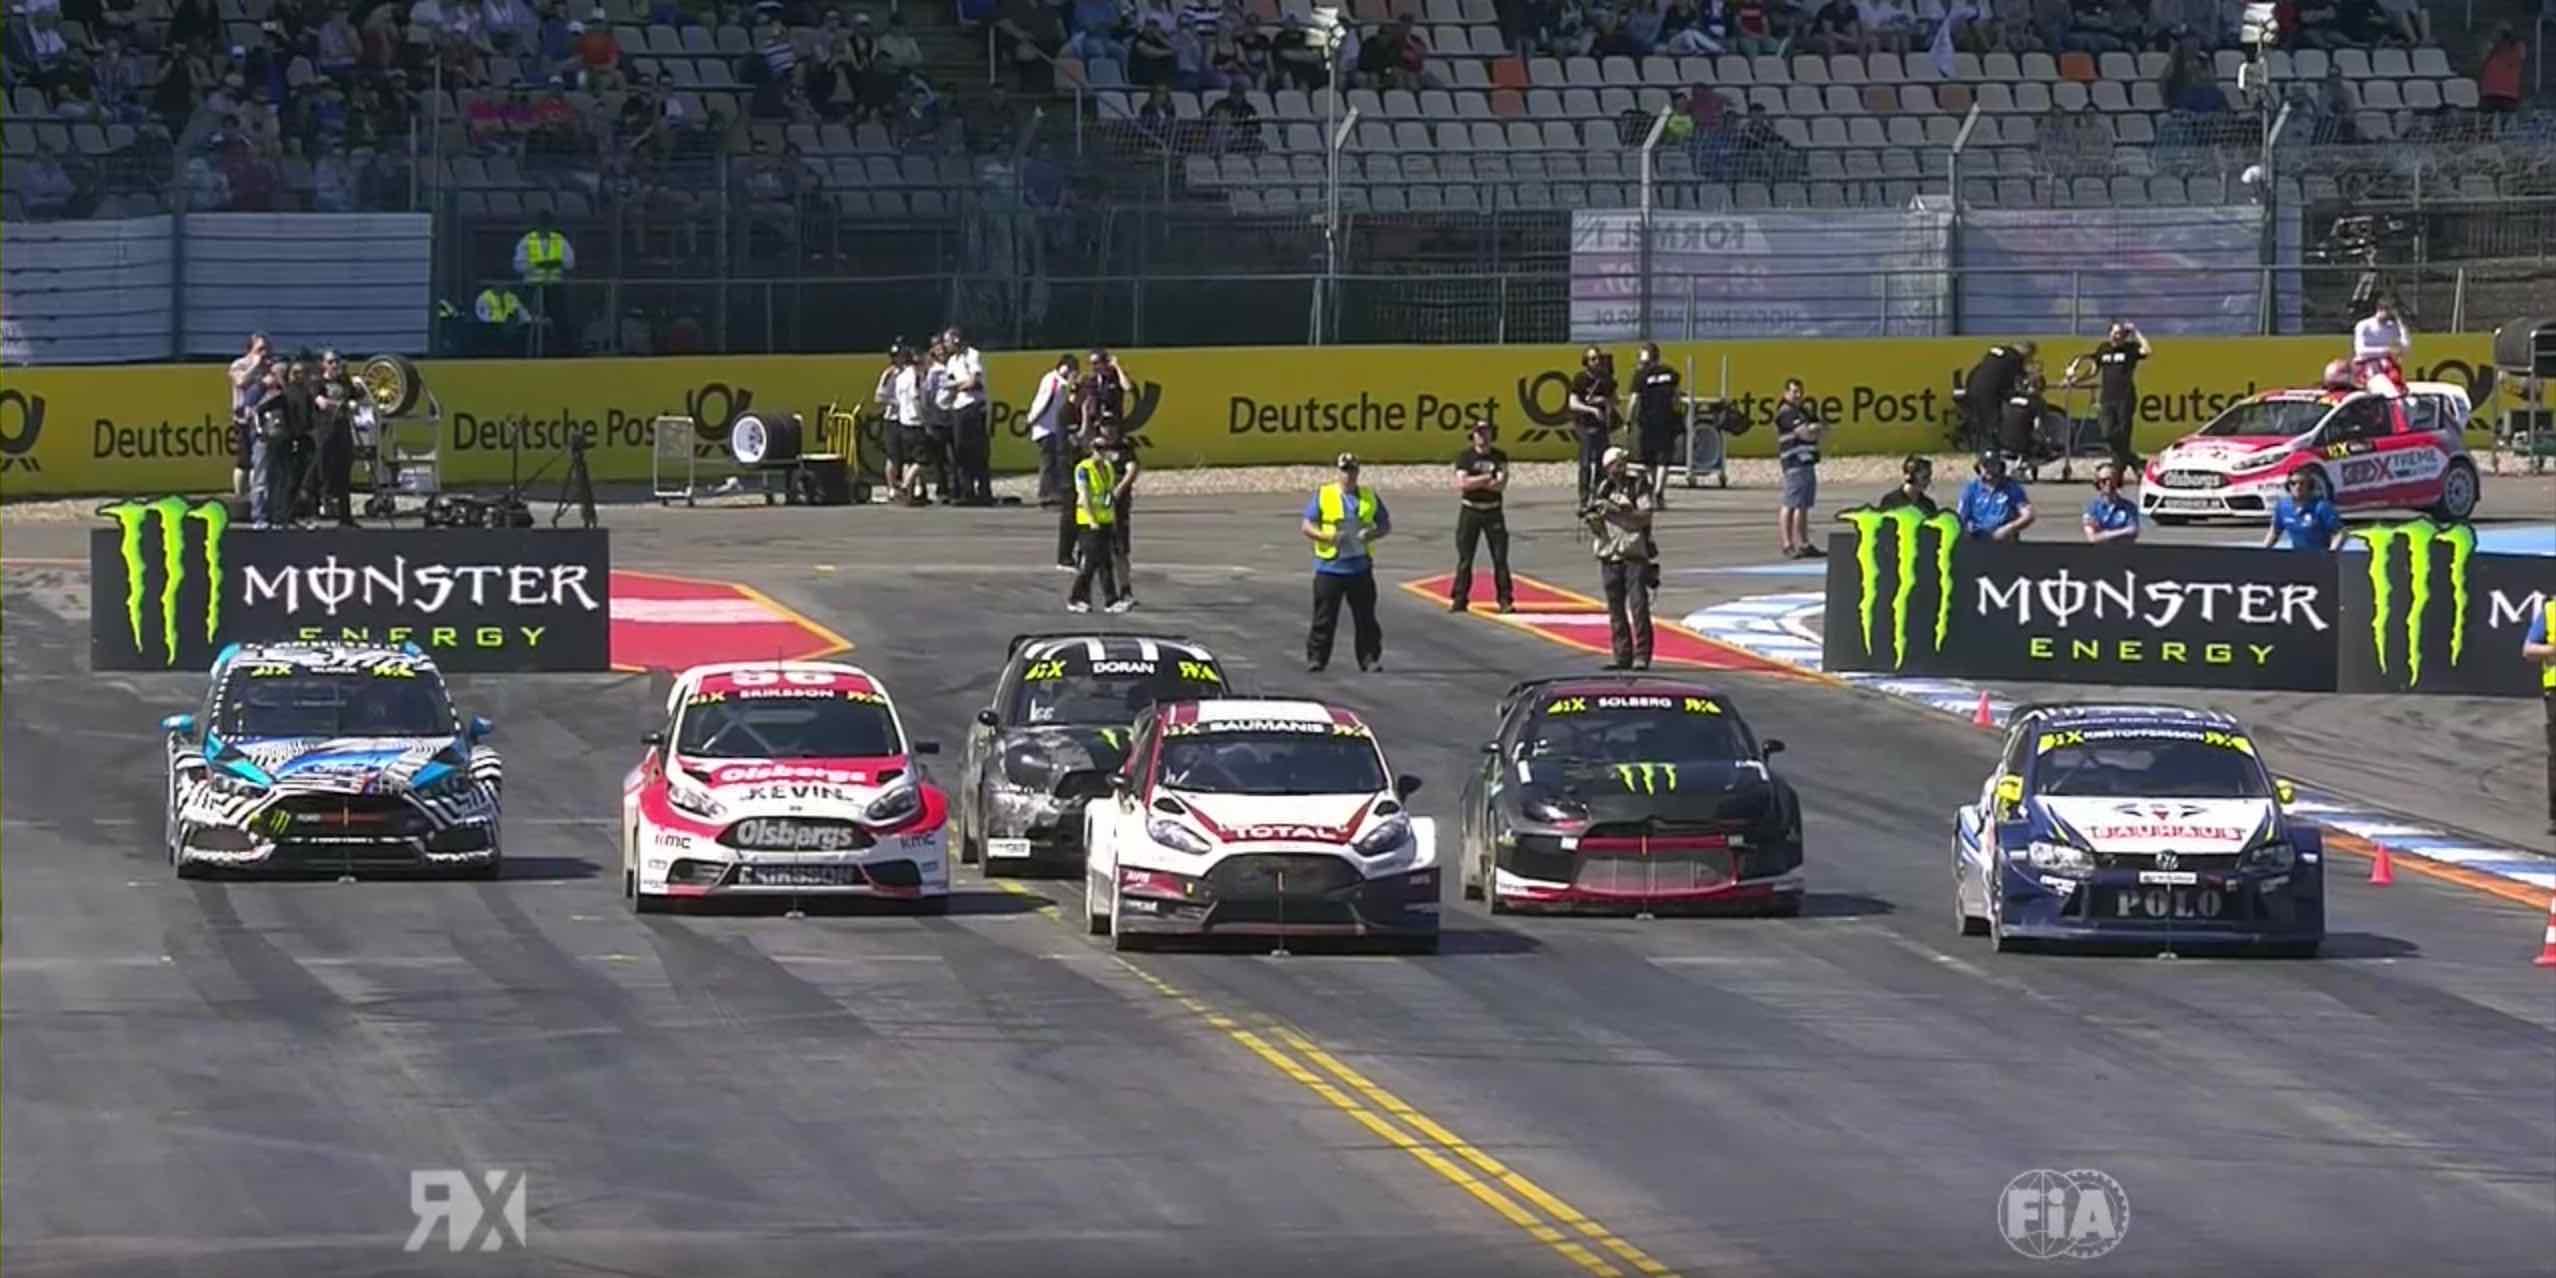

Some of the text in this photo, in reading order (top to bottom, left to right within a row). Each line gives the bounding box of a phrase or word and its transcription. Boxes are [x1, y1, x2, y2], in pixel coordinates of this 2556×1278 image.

[1228, 391, 1500, 442] Deutsche Post
[1852, 386, 1937, 425] Post
[93, 413, 241, 459] Deutsche
[453, 408, 672, 451] Deutsche Pos
[243, 554, 598, 617] MONSTER
[1976, 569, 2329, 630] MONSTER
[2029, 637, 2276, 665] ENERGY
[1092, 661, 1156, 674] DORAN
[739, 688, 835, 700] ERIKSSON
[1598, 696, 1673, 709] SOLBERG
[1209, 719, 1326, 733] BAUMANIS
[719, 765, 867, 784] Olsbergs
[744, 785, 846, 800] KEVIN
[736, 818, 855, 850] Olsbergs
[1233, 825, 1338, 840] TOTAL
[2116, 888, 2222, 918] POLO
